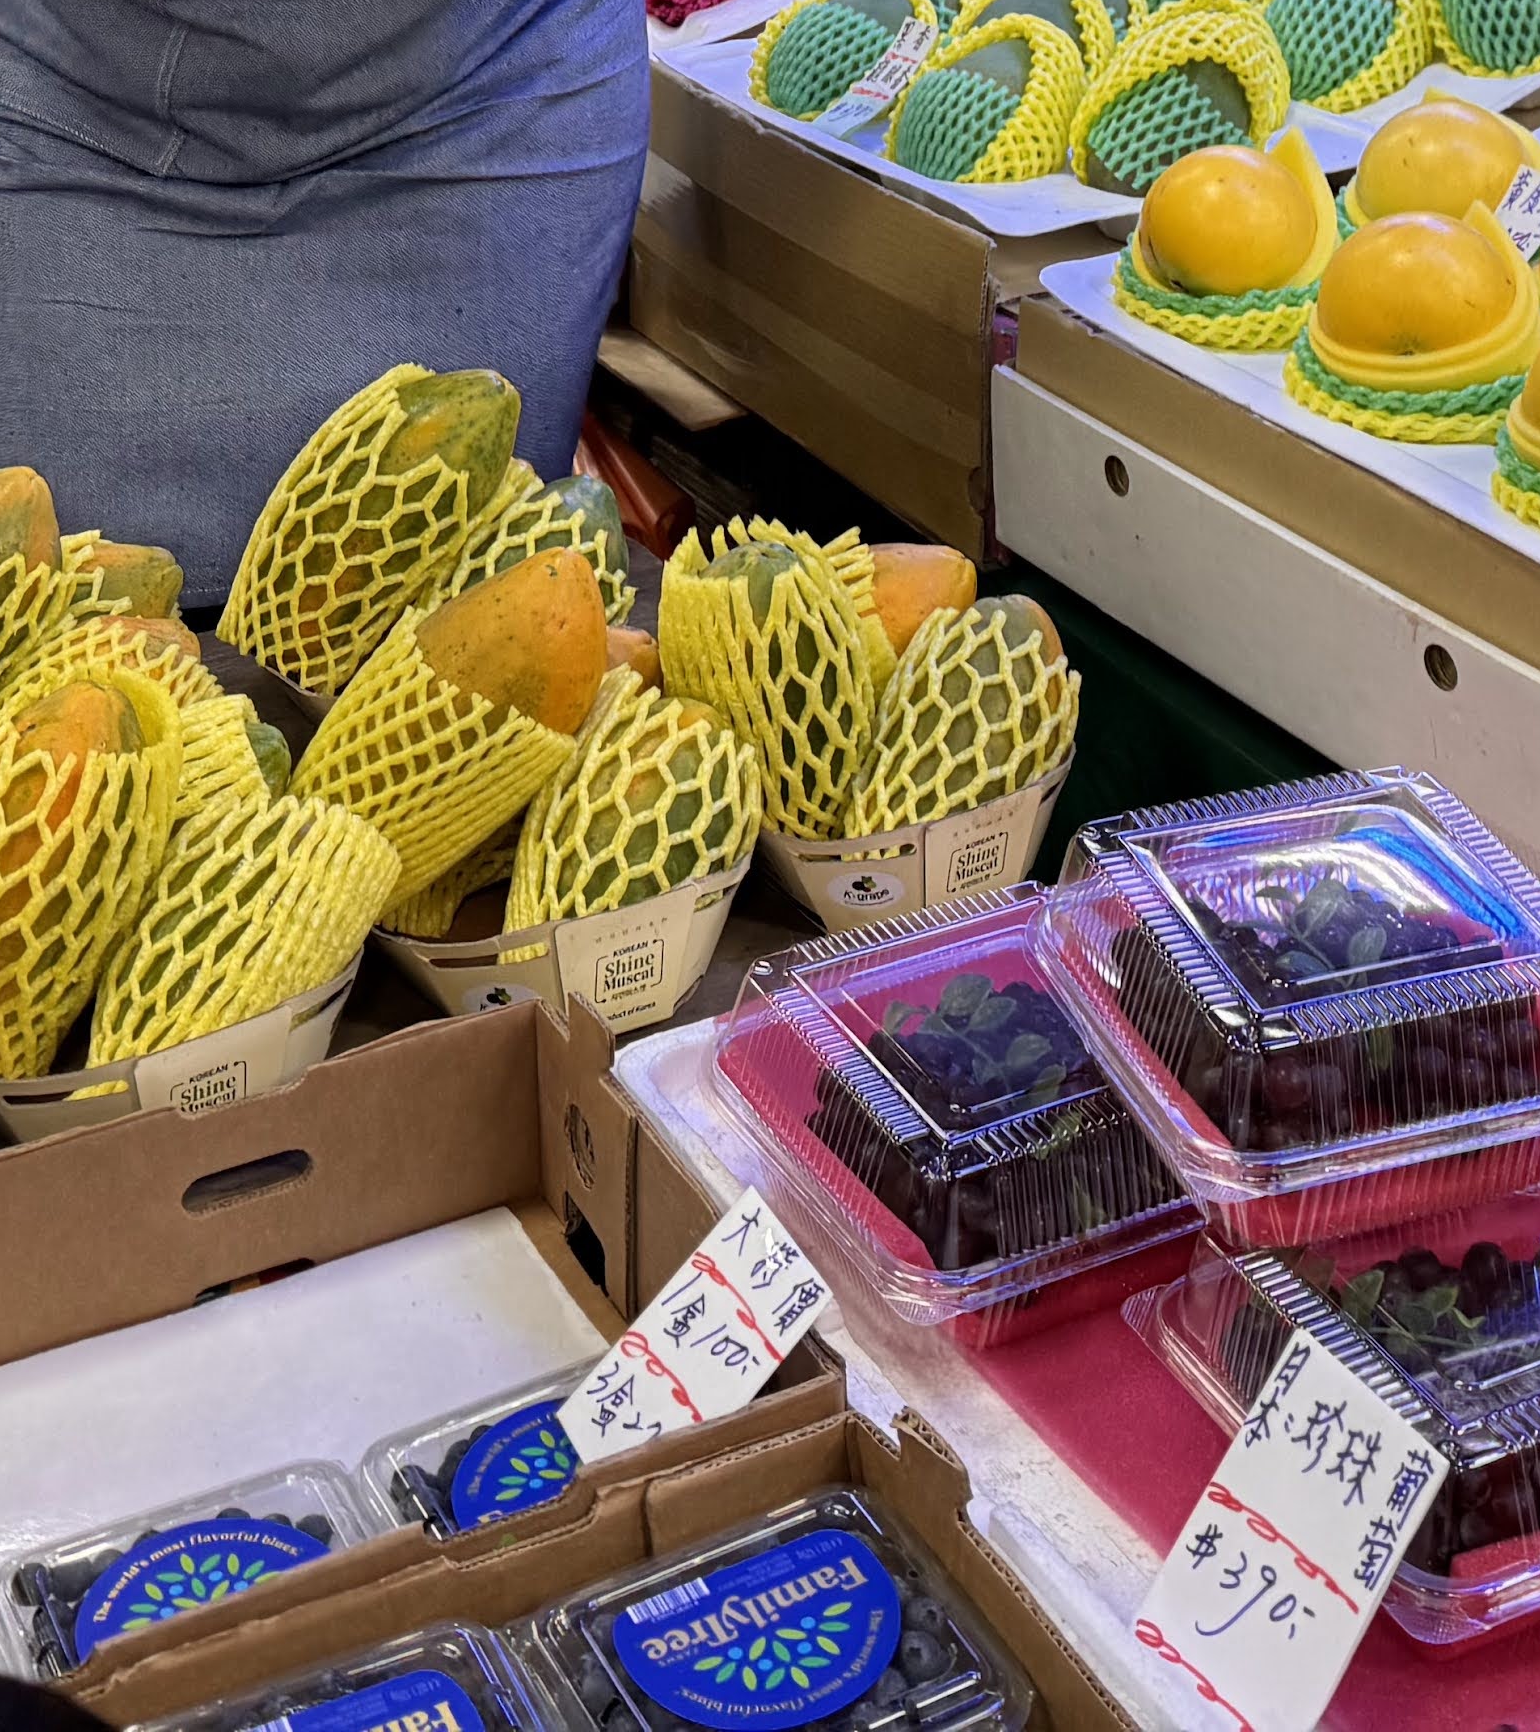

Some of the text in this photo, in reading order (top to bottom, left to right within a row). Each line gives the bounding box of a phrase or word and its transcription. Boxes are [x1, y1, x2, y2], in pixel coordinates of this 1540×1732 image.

[966, 834, 996, 849] KOREAN
[957, 844, 1000, 868] Shine
[954, 857, 999, 882] Muscat
[613, 940, 649, 958] KOREAN
[605, 951, 655, 978] Shine
[603, 967, 655, 992] Muscat
[189, 1064, 228, 1084] KOREAN
[181, 1076, 236, 1105] Shine
[93, 1602, 111, 1623] The
[109, 1559, 150, 1604] world's
[149, 1540, 186, 1563] most
[188, 1531, 261, 1545] flavorful
[641, 1557, 868, 1660] FamilyTree
[807, 1678, 843, 1704] most
[727, 1698, 805, 1718] flavorful
